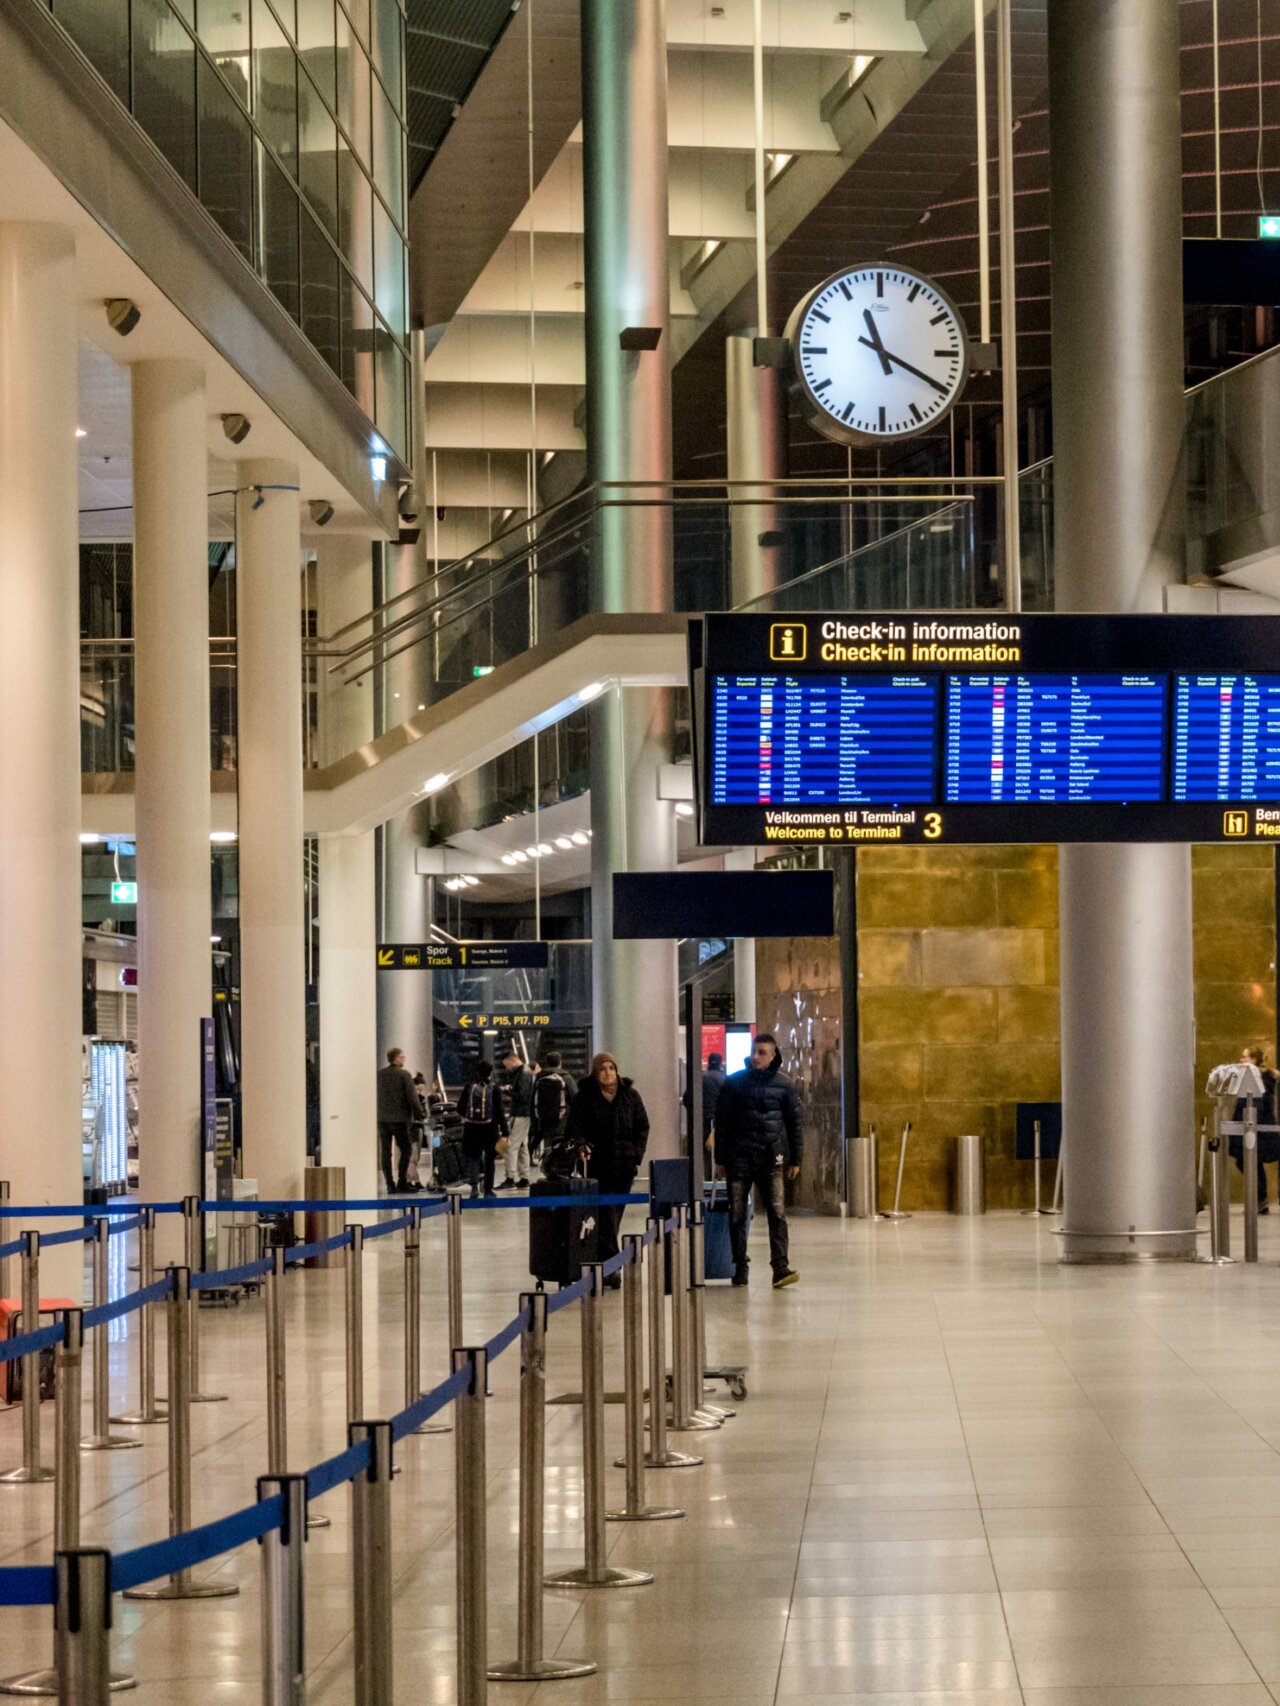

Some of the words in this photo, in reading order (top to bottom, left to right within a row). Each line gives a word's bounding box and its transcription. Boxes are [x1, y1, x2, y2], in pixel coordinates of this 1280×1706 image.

[821, 621, 906, 640] Check-in
[912, 621, 1020, 640] information
[821, 643, 906, 661] Check-in
[912, 643, 1020, 661] information
[765, 811, 841, 824] Velkommen
[845, 810, 858, 824] til
[861, 810, 916, 824] Terminal
[765, 826, 826, 839] Welcome
[829, 827, 843, 839] to
[846, 825, 901, 839] Terminal
[923, 812, 943, 839] 3
[426, 945, 449, 956] Spor
[458, 946, 467, 965] 1
[427, 955, 453, 966] Track
[492, 1015, 511, 1026] P15,
[513, 1015, 531, 1026] P17,
[533, 1014, 550, 1025] P19
